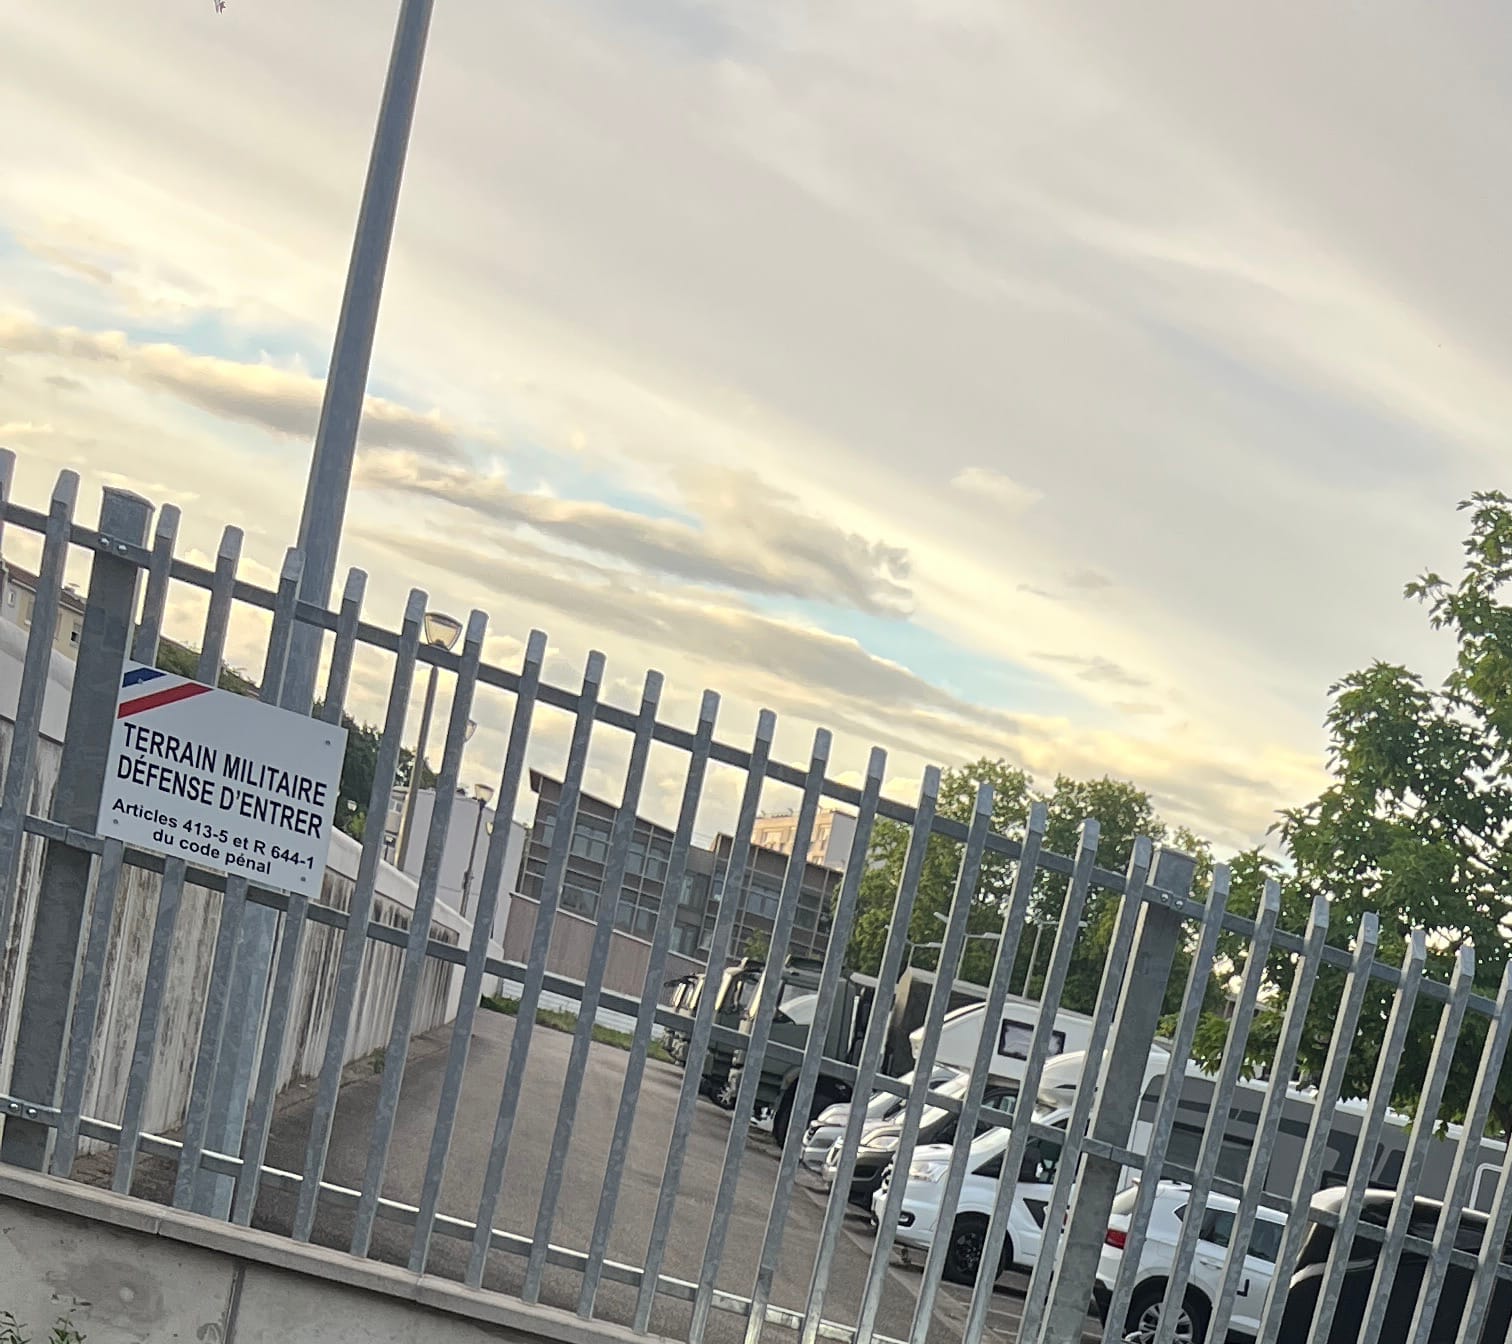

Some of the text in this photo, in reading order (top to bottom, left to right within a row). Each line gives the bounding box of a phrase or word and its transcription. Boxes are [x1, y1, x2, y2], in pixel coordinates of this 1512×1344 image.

[117, 753, 323, 839] DÉFENSE D'ENTRER
[124, 722, 327, 807] TERRAIN MILITAIRE
[112, 798, 314, 870] Articles 413-5 et R 644-1
[152, 829, 272, 875] du code pénal
